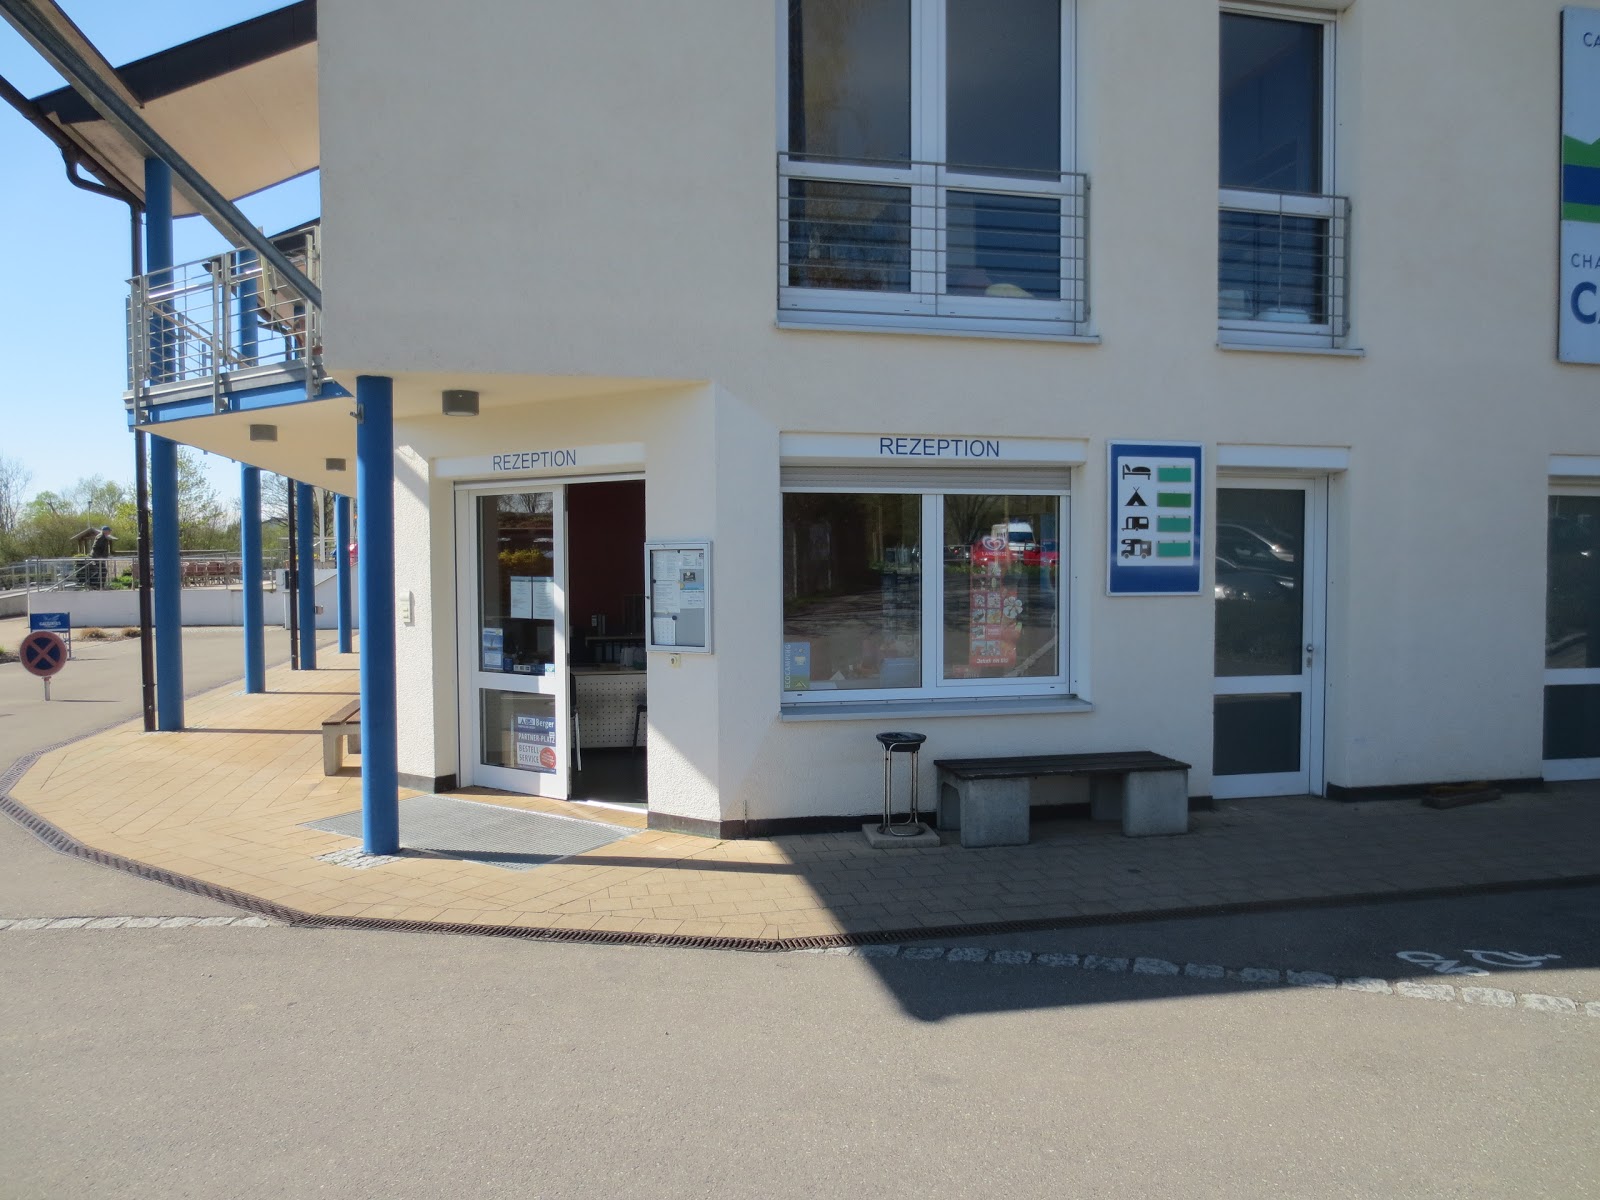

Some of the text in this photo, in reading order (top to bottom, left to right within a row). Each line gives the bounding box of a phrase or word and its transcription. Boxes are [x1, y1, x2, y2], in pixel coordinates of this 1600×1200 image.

[1570, 281, 1600, 325] C
[880, 437, 1000, 457] REZEPTION
[492, 449, 576, 471] REZEPTION
[535, 719, 554, 729] Berger
[519, 745, 539, 754] BESTELL
[519, 754, 539, 763] SERVICE
